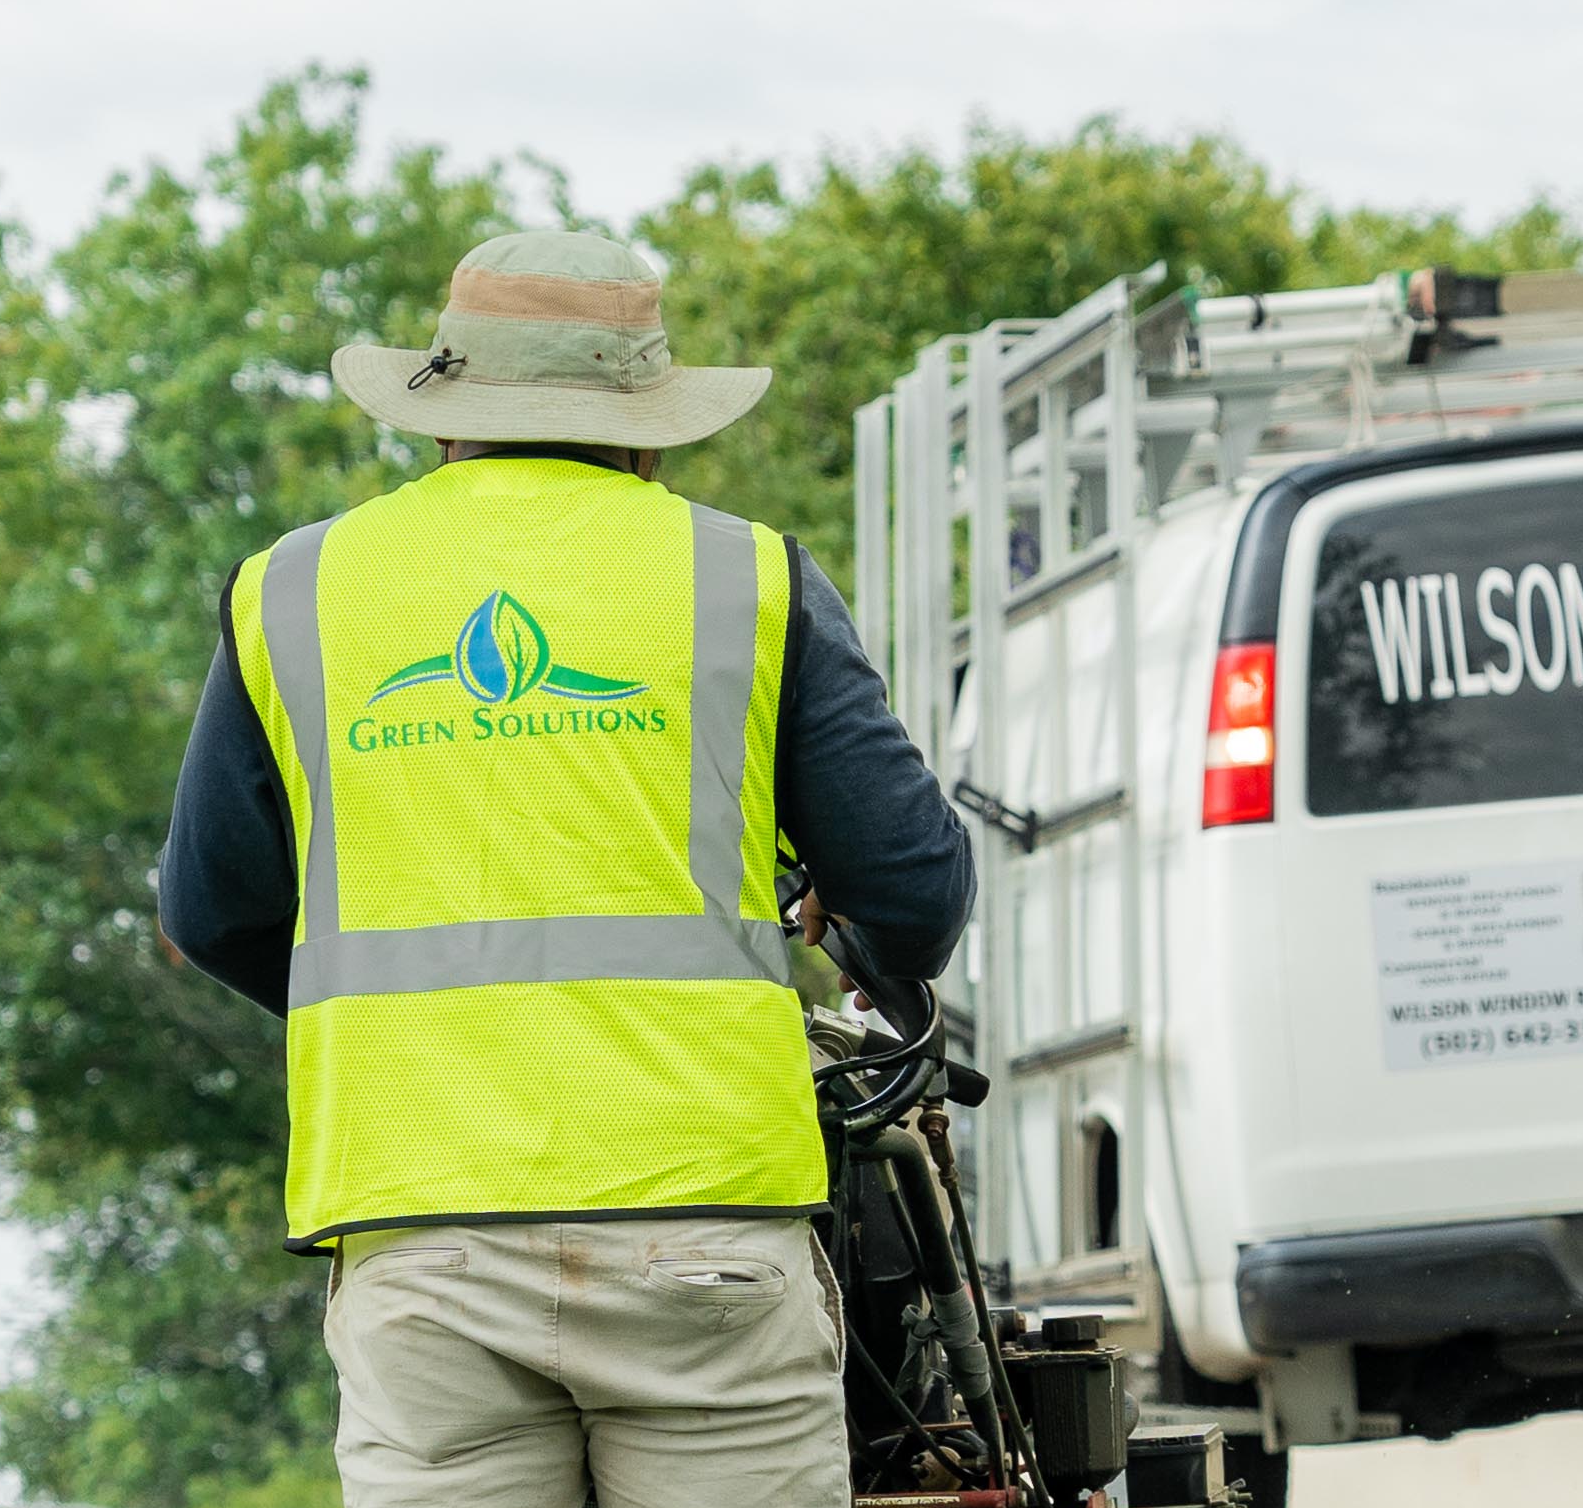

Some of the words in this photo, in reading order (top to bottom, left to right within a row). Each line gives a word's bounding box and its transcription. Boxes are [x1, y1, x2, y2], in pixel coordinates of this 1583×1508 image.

[1389, 998, 1471, 1023] WILSON
[1478, 987, 1569, 1015] WINDOW
[1420, 1025, 1496, 1061] (502)
